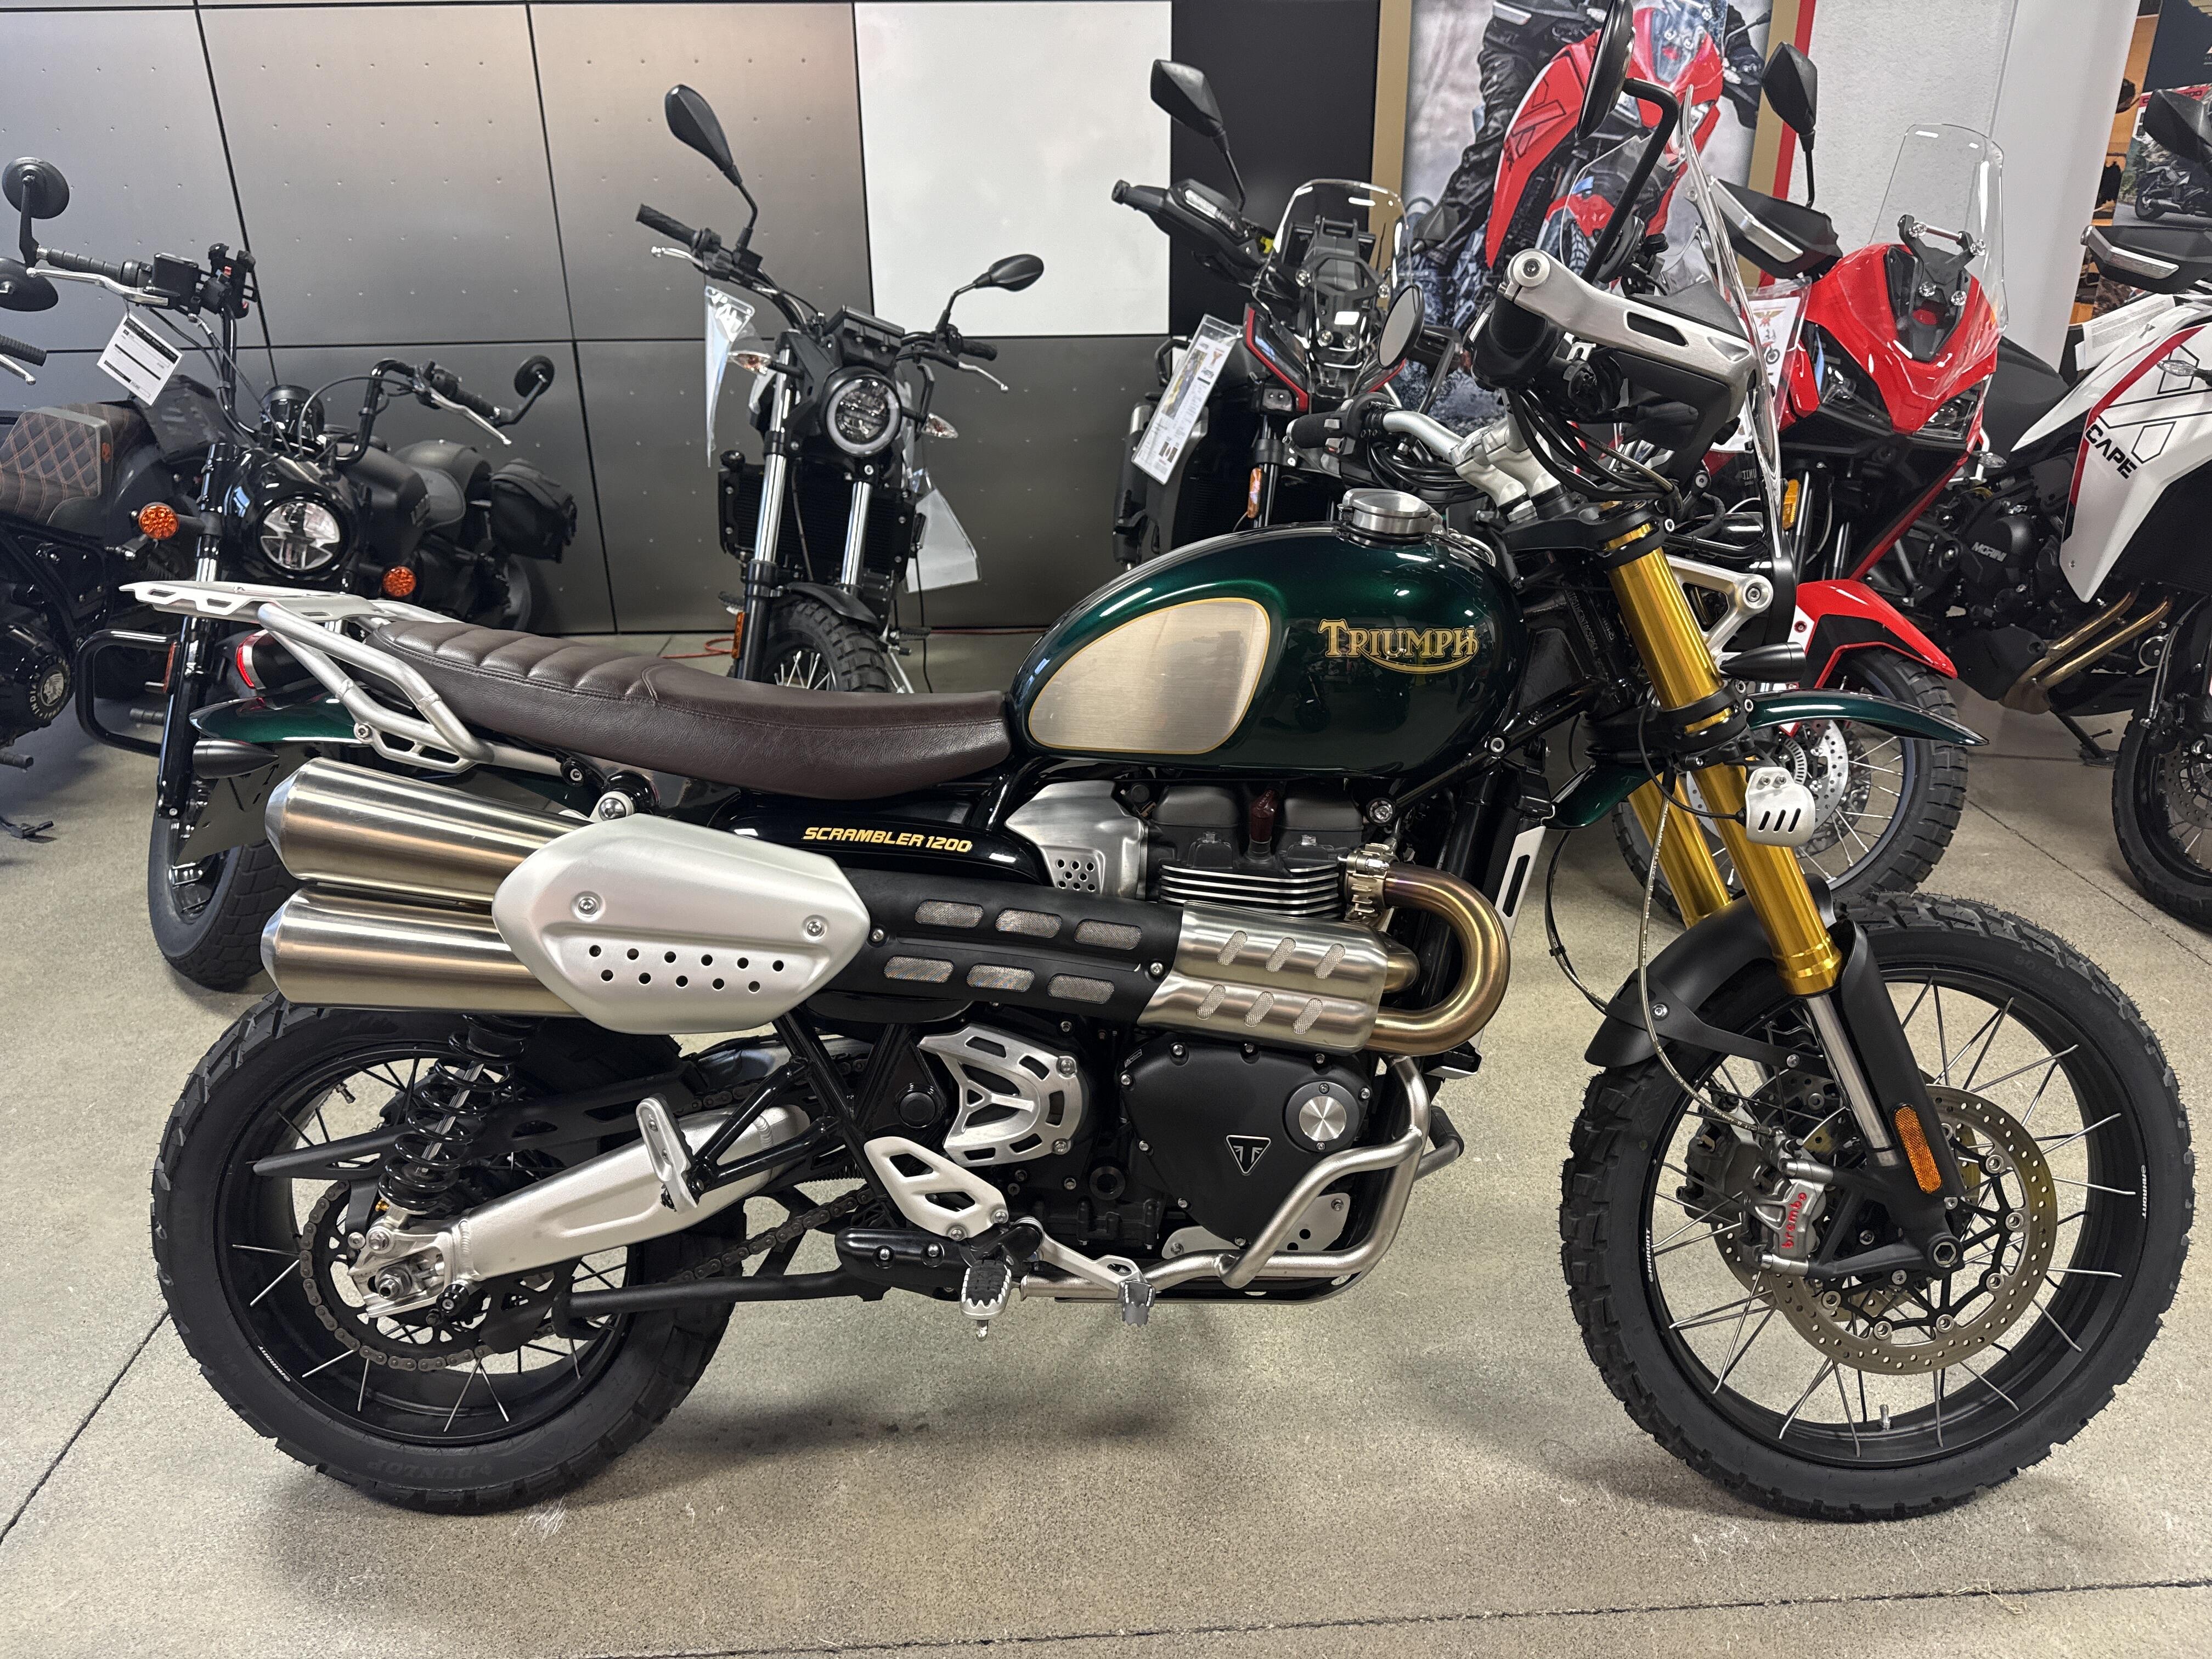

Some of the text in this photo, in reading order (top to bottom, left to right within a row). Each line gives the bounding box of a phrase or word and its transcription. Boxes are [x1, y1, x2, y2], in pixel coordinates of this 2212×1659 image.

[2085, 424, 2138, 479] CAPE
[1971, 541, 2007, 562] MORINI
[1317, 618, 1480, 658] TRIUMPH
[803, 827, 973, 853] SCRAMBLER 1200
[1781, 1192, 1807, 1248] brembo
